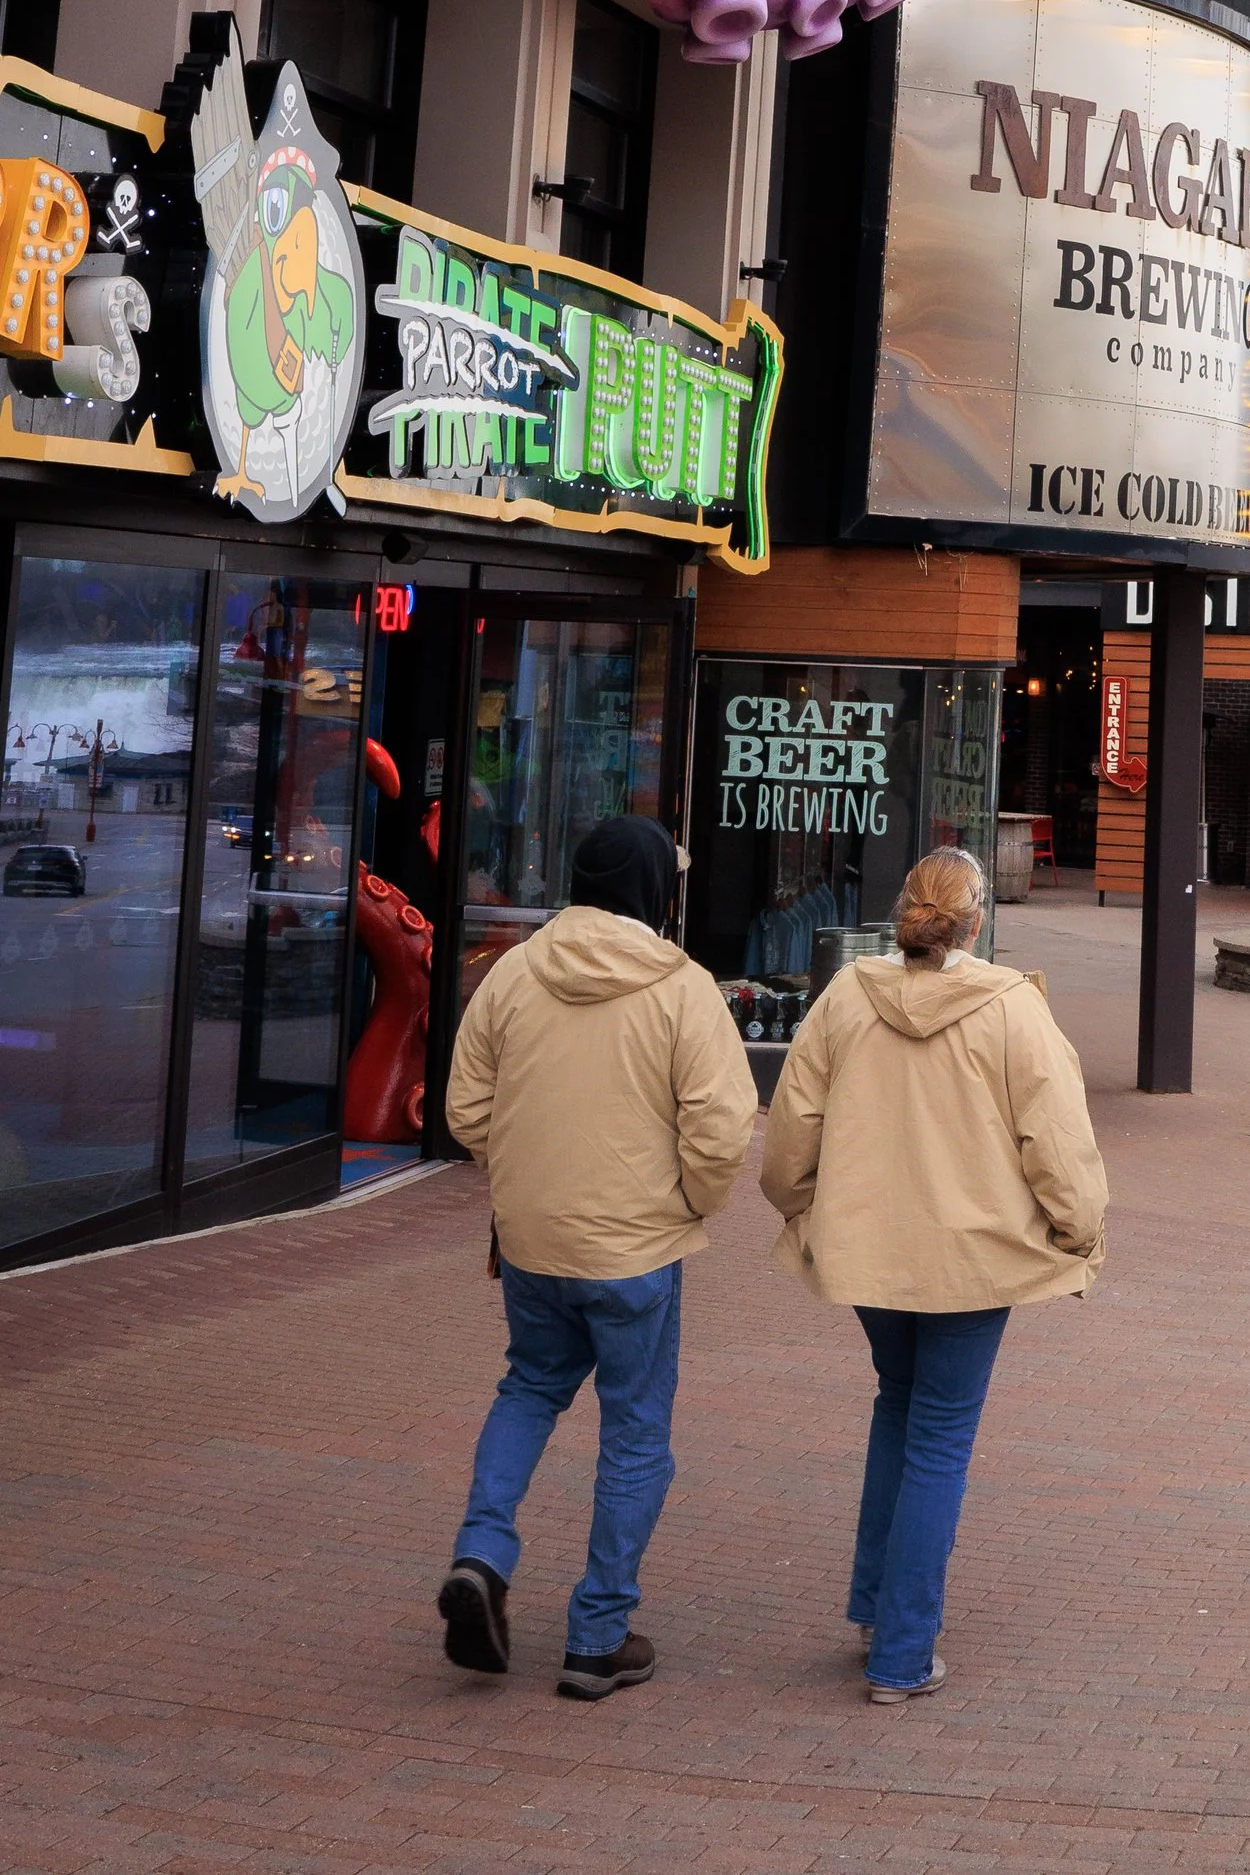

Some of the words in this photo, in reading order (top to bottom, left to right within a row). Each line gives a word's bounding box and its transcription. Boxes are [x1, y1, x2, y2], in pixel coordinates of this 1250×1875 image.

[403, 319, 541, 396] PARROT
[1106, 334, 1237, 392] company
[583, 311, 753, 501] PUTT
[1027, 464, 1105, 518] ICE
[1117, 471, 1203, 527] COLD
[355, 586, 410, 631] PEN
[725, 695, 894, 736] CRAFT
[1106, 682, 1121, 774] ENTRANCE
[722, 735, 890, 785] BEER
[719, 782, 747, 828] IS
[756, 783, 888, 836] BREWING
